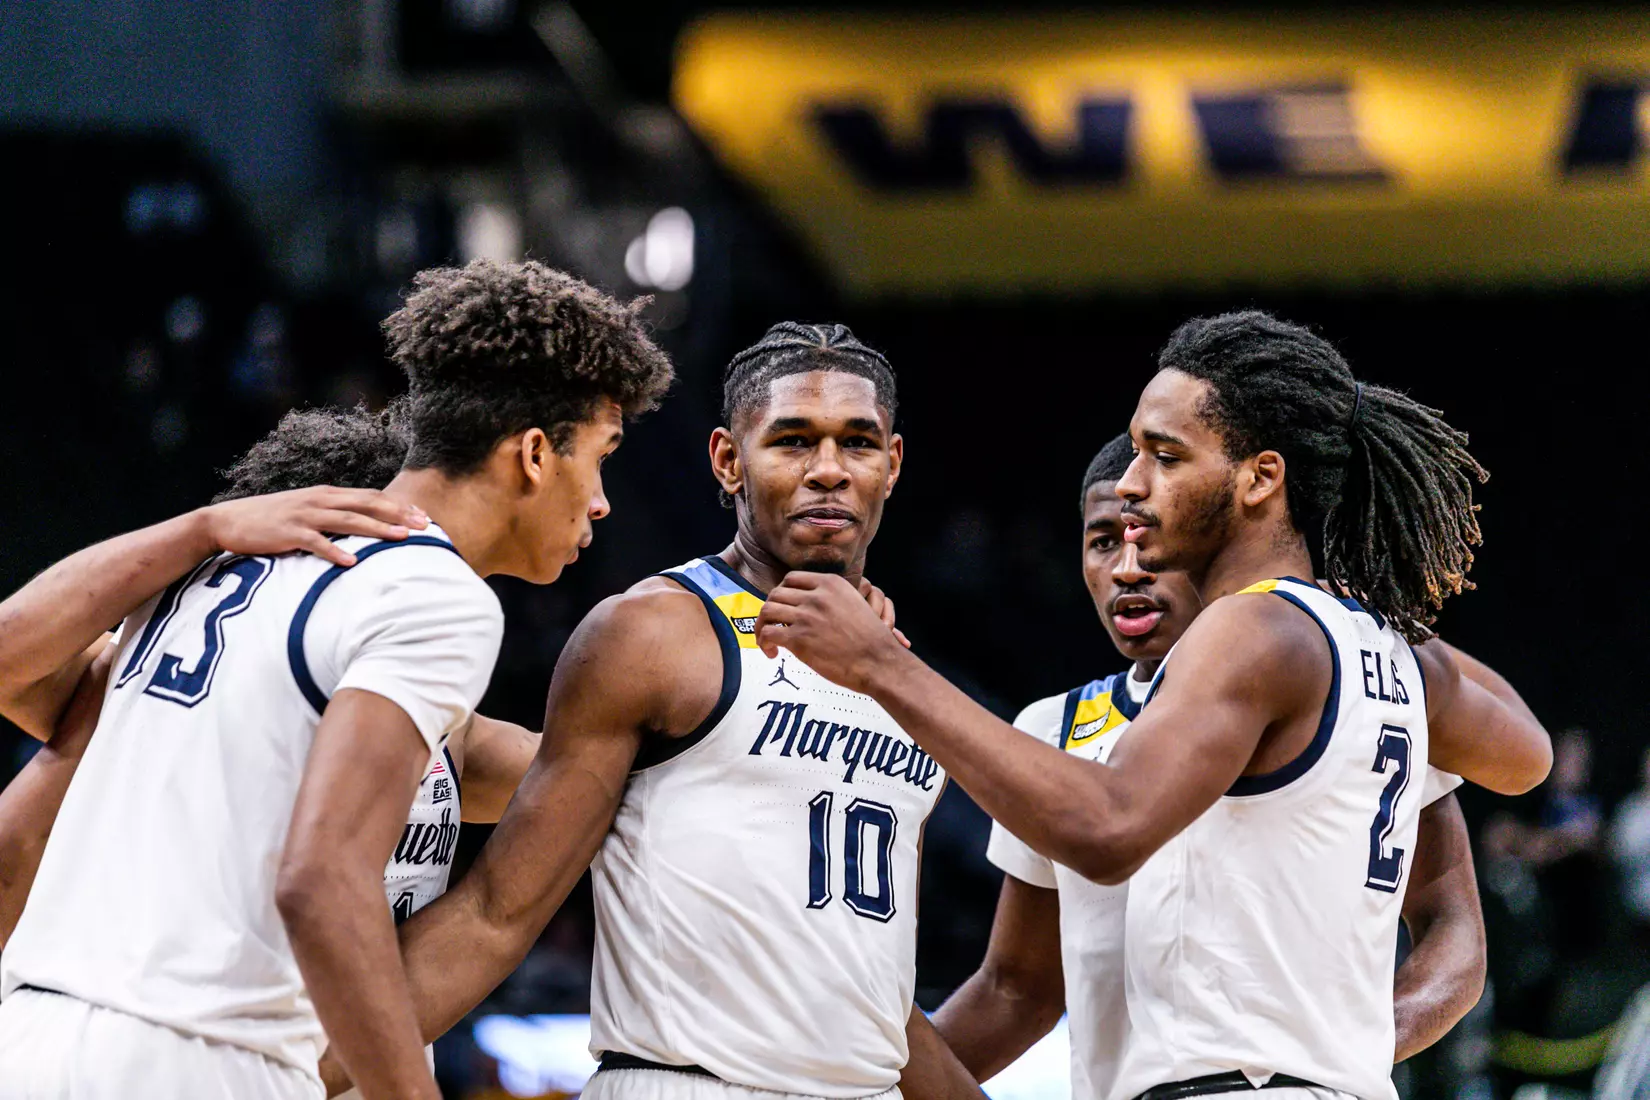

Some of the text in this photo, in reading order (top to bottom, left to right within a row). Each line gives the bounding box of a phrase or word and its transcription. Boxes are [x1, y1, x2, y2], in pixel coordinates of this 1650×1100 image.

[114, 552, 276, 708] 13
[1360, 649, 1410, 704] ELS
[433, 778, 449, 789] BIG
[748, 700, 938, 791] Marquette
[394, 808, 457, 865] uette
[1364, 723, 1412, 893] 2
[806, 791, 898, 923] 10
